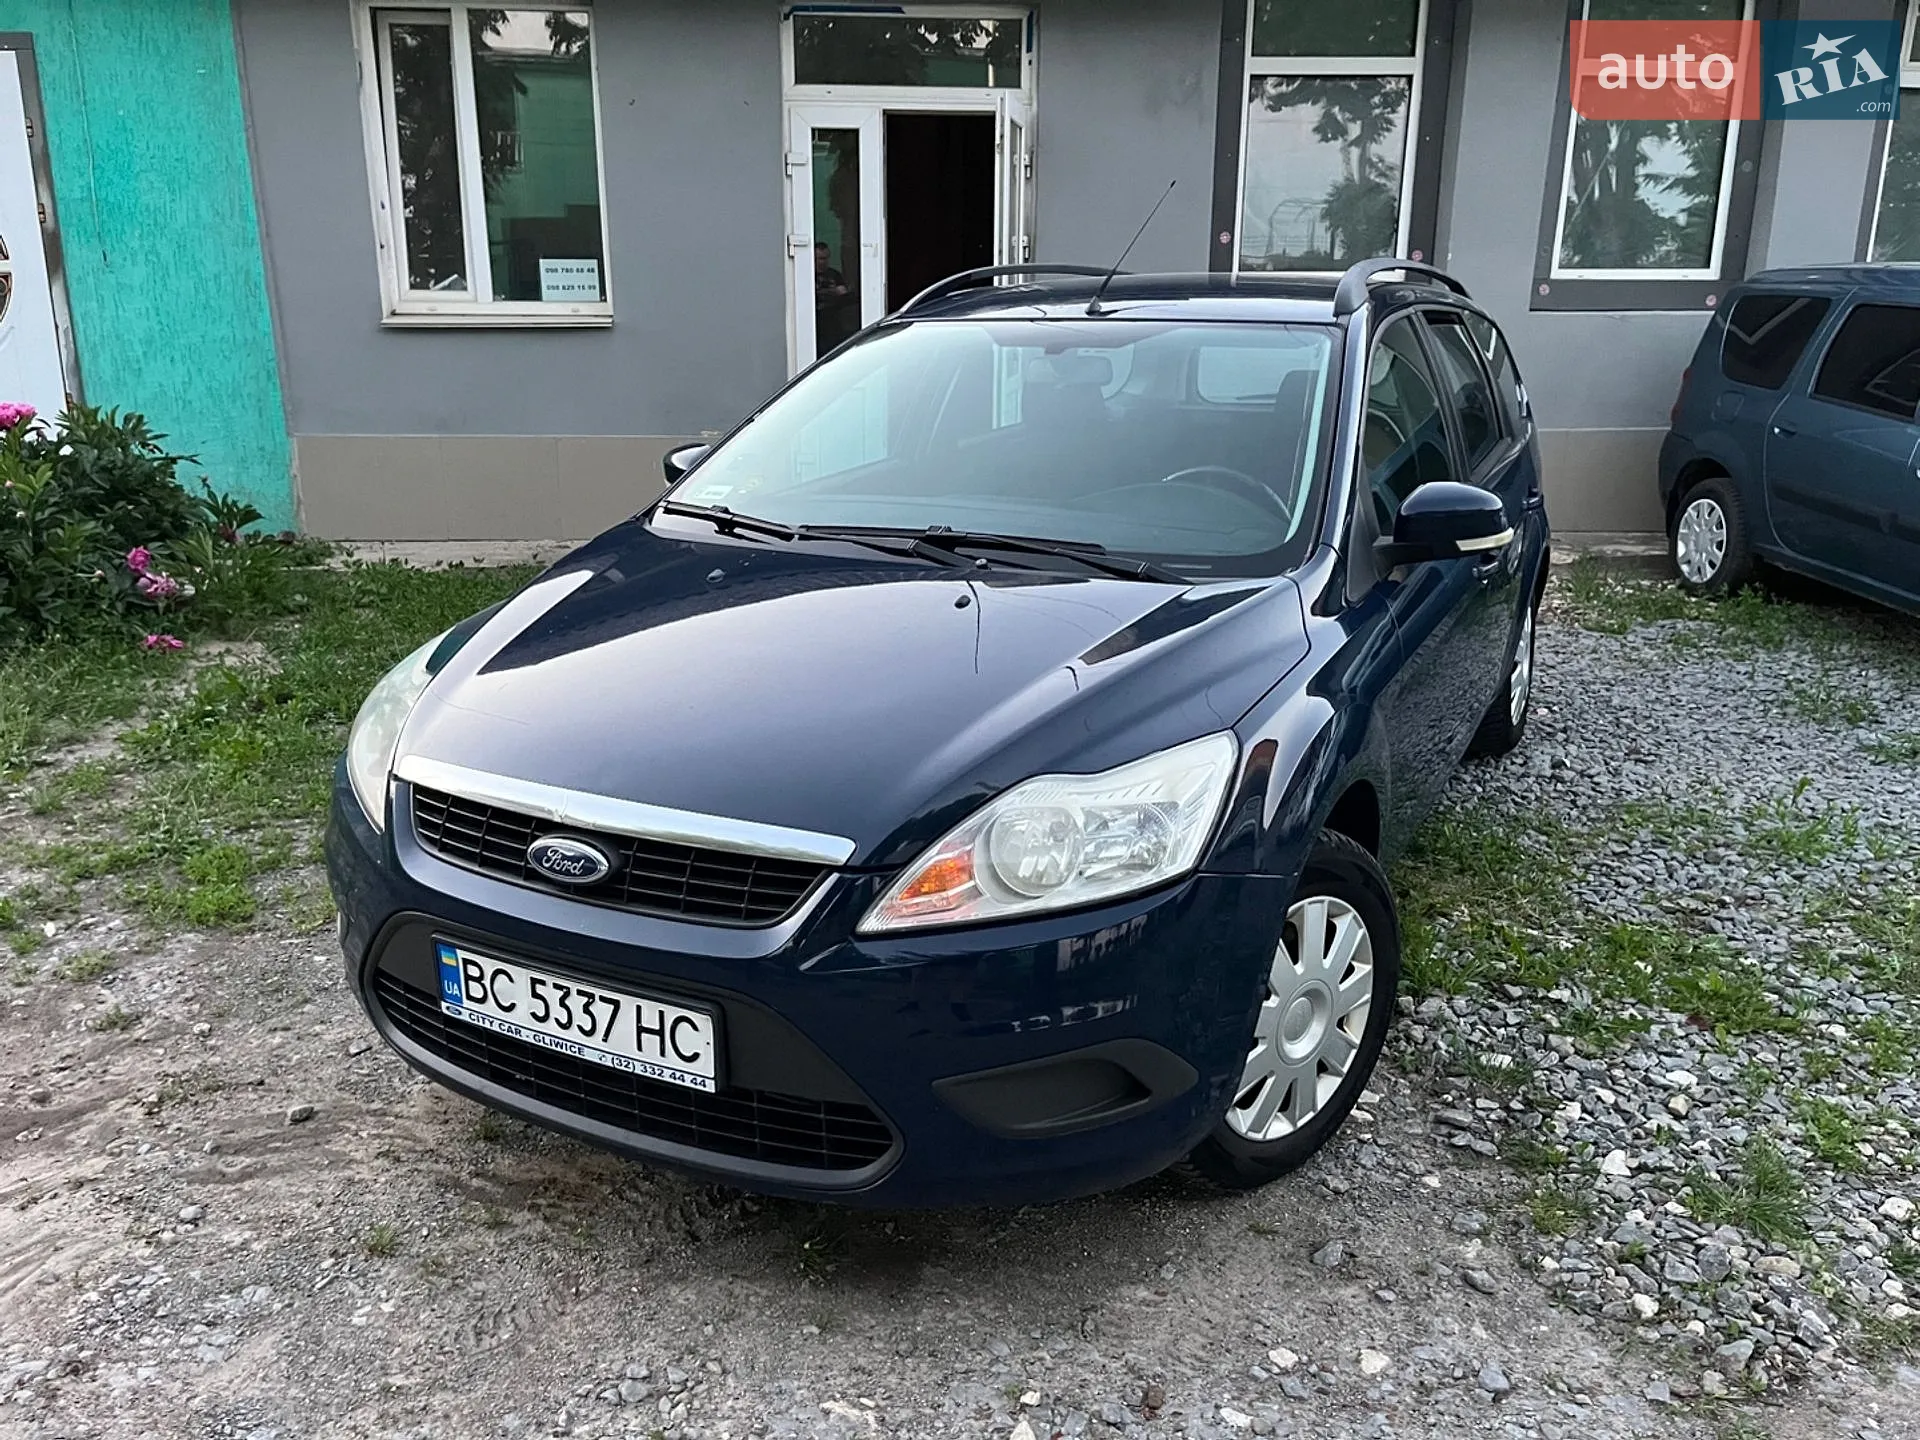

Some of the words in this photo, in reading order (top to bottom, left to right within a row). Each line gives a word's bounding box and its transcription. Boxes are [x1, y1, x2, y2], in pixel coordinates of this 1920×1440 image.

[542, 846, 586, 875] Ford
[444, 980, 461, 997] UA
[461, 957, 516, 1013] BC
[529, 976, 621, 1043] 5337
[635, 1004, 700, 1063] HC
[468, 1012, 496, 1028] CITY
[498, 1022, 523, 1039] CAR
[533, 1034, 586, 1057] GLIWICE
[610, 1056, 636, 1073] (32)
[640, 1064, 665, 1078] 332
[669, 1071, 686, 1083] 44
[690, 1076, 707, 1089] 44
